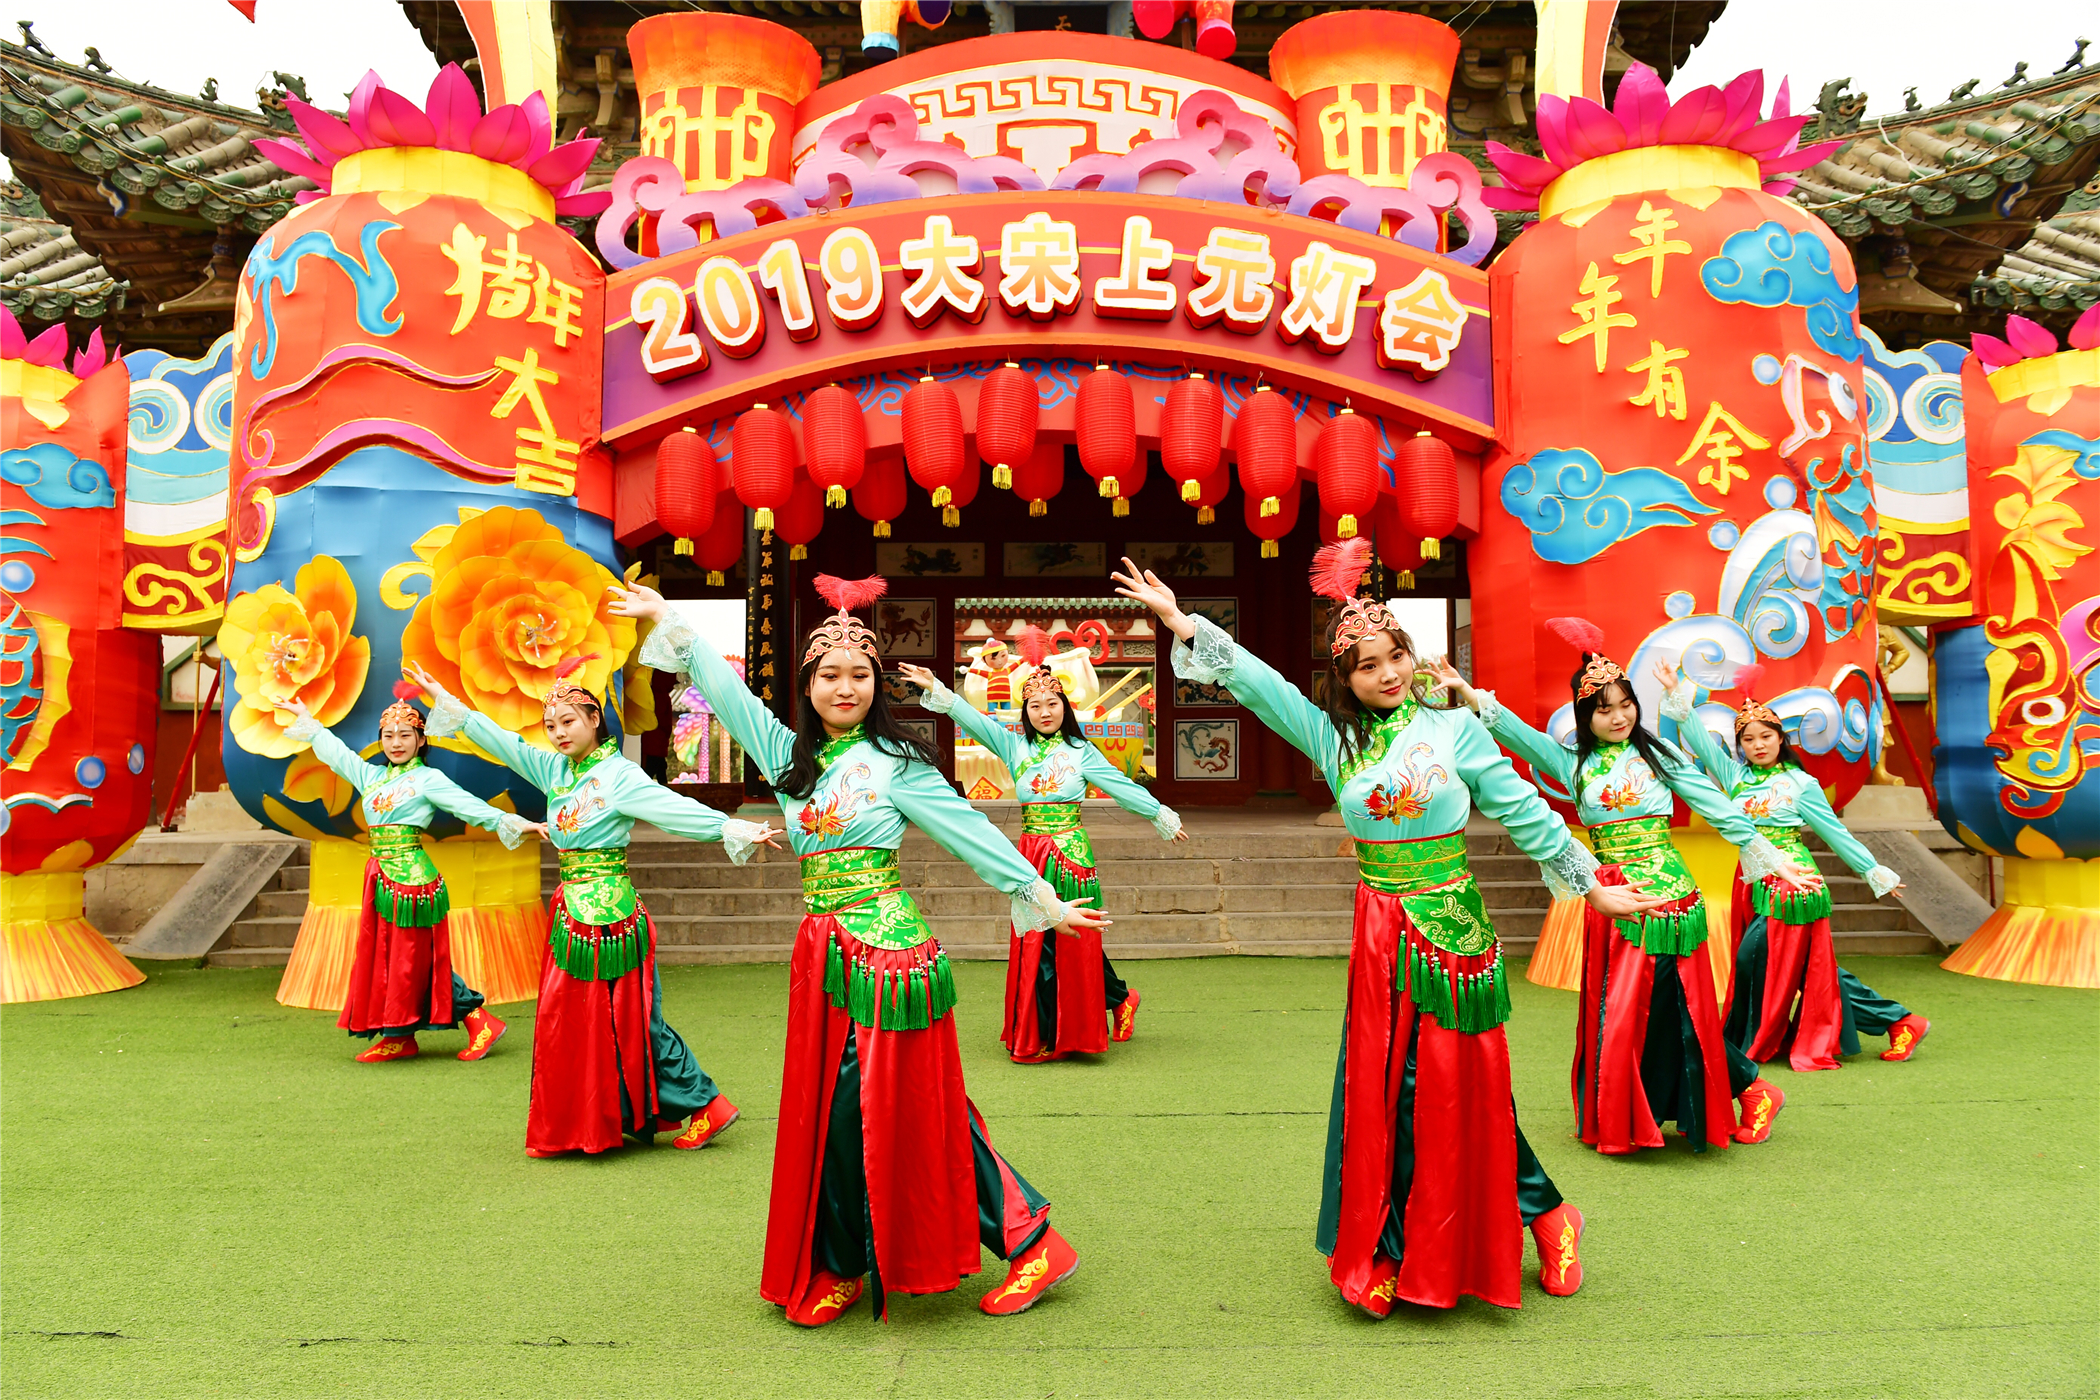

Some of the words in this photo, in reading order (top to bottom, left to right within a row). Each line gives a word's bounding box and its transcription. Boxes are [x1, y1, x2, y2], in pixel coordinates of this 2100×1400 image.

[440, 221, 584, 497] 猪年大吉
[630, 211, 1469, 380] 2019大宋上元灯会
[1557, 199, 1772, 496] 年年有余
[975, 785, 993, 800] 福
